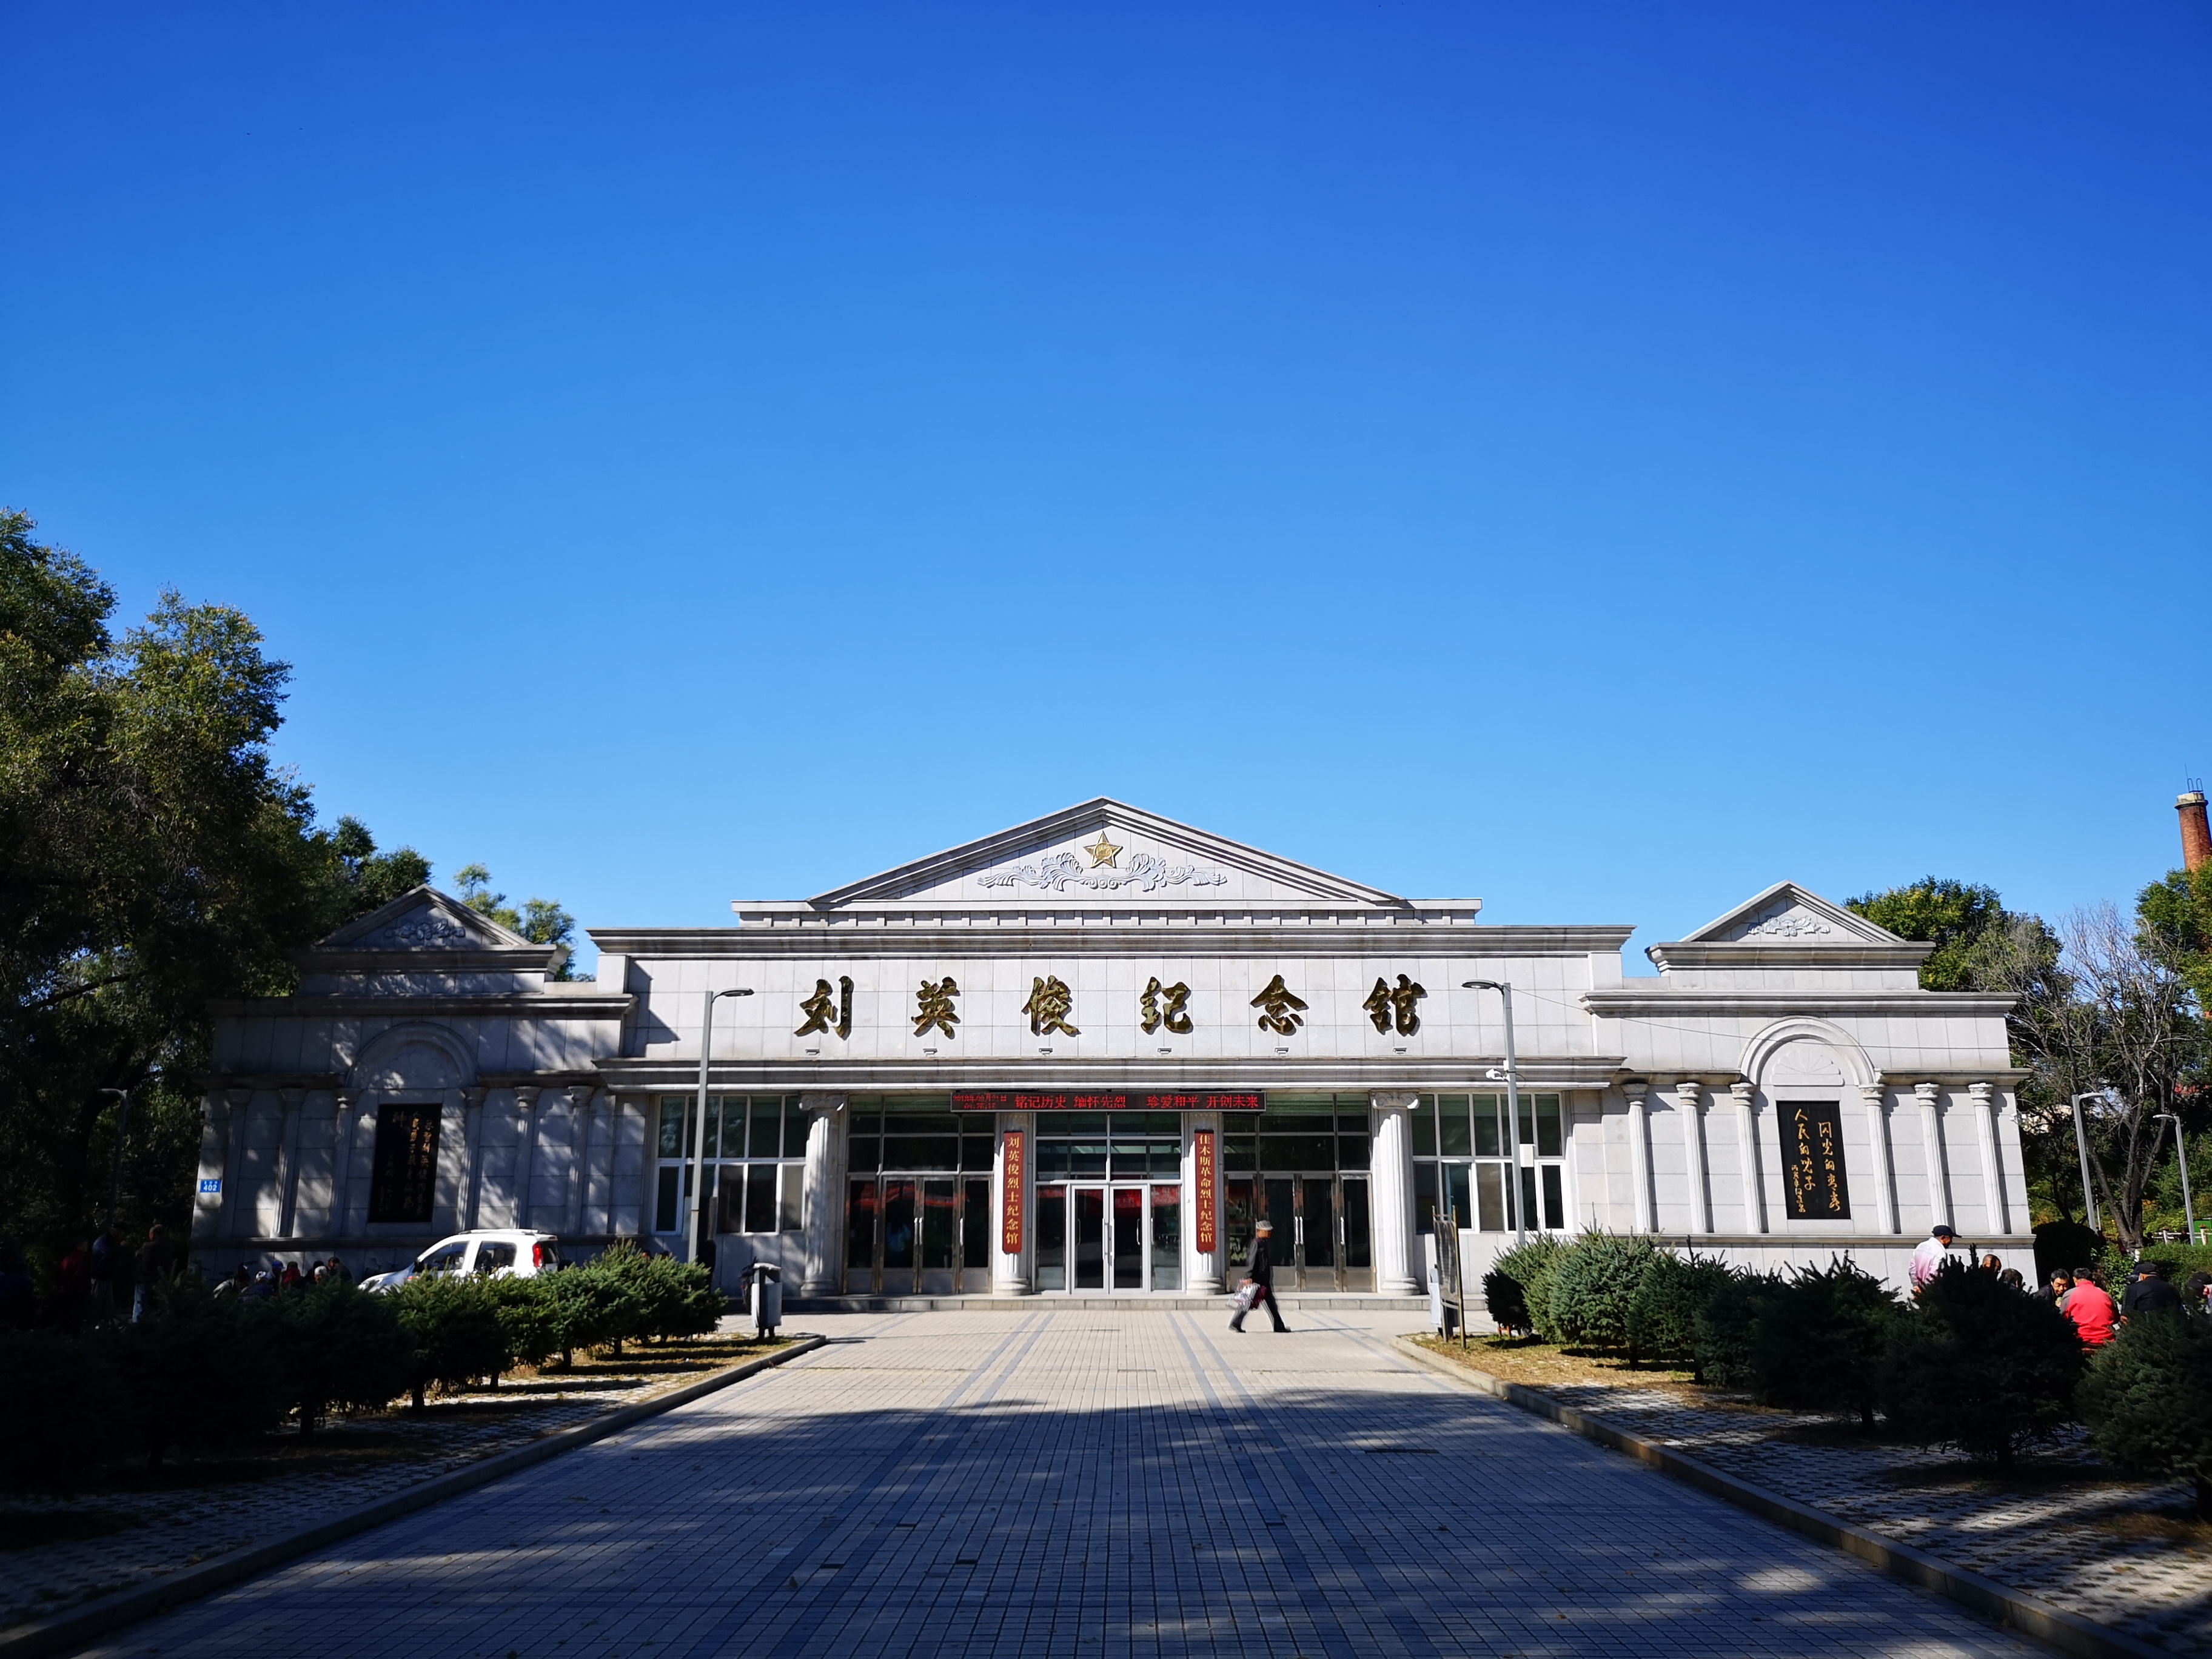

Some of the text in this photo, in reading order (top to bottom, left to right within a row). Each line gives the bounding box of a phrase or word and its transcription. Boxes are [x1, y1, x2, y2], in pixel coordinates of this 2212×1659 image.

[794, 974, 1426, 1039] 刘英俊纪念馆
[1014, 1095, 1259, 1109] 铭记历史 缅怀先烈 珍爱和平 开创未来
[1006, 1137, 1020, 1245] 刘英俊烈士纪念馆
[1199, 1134, 1212, 1243] 佳木斯革命烈士纪念馆
